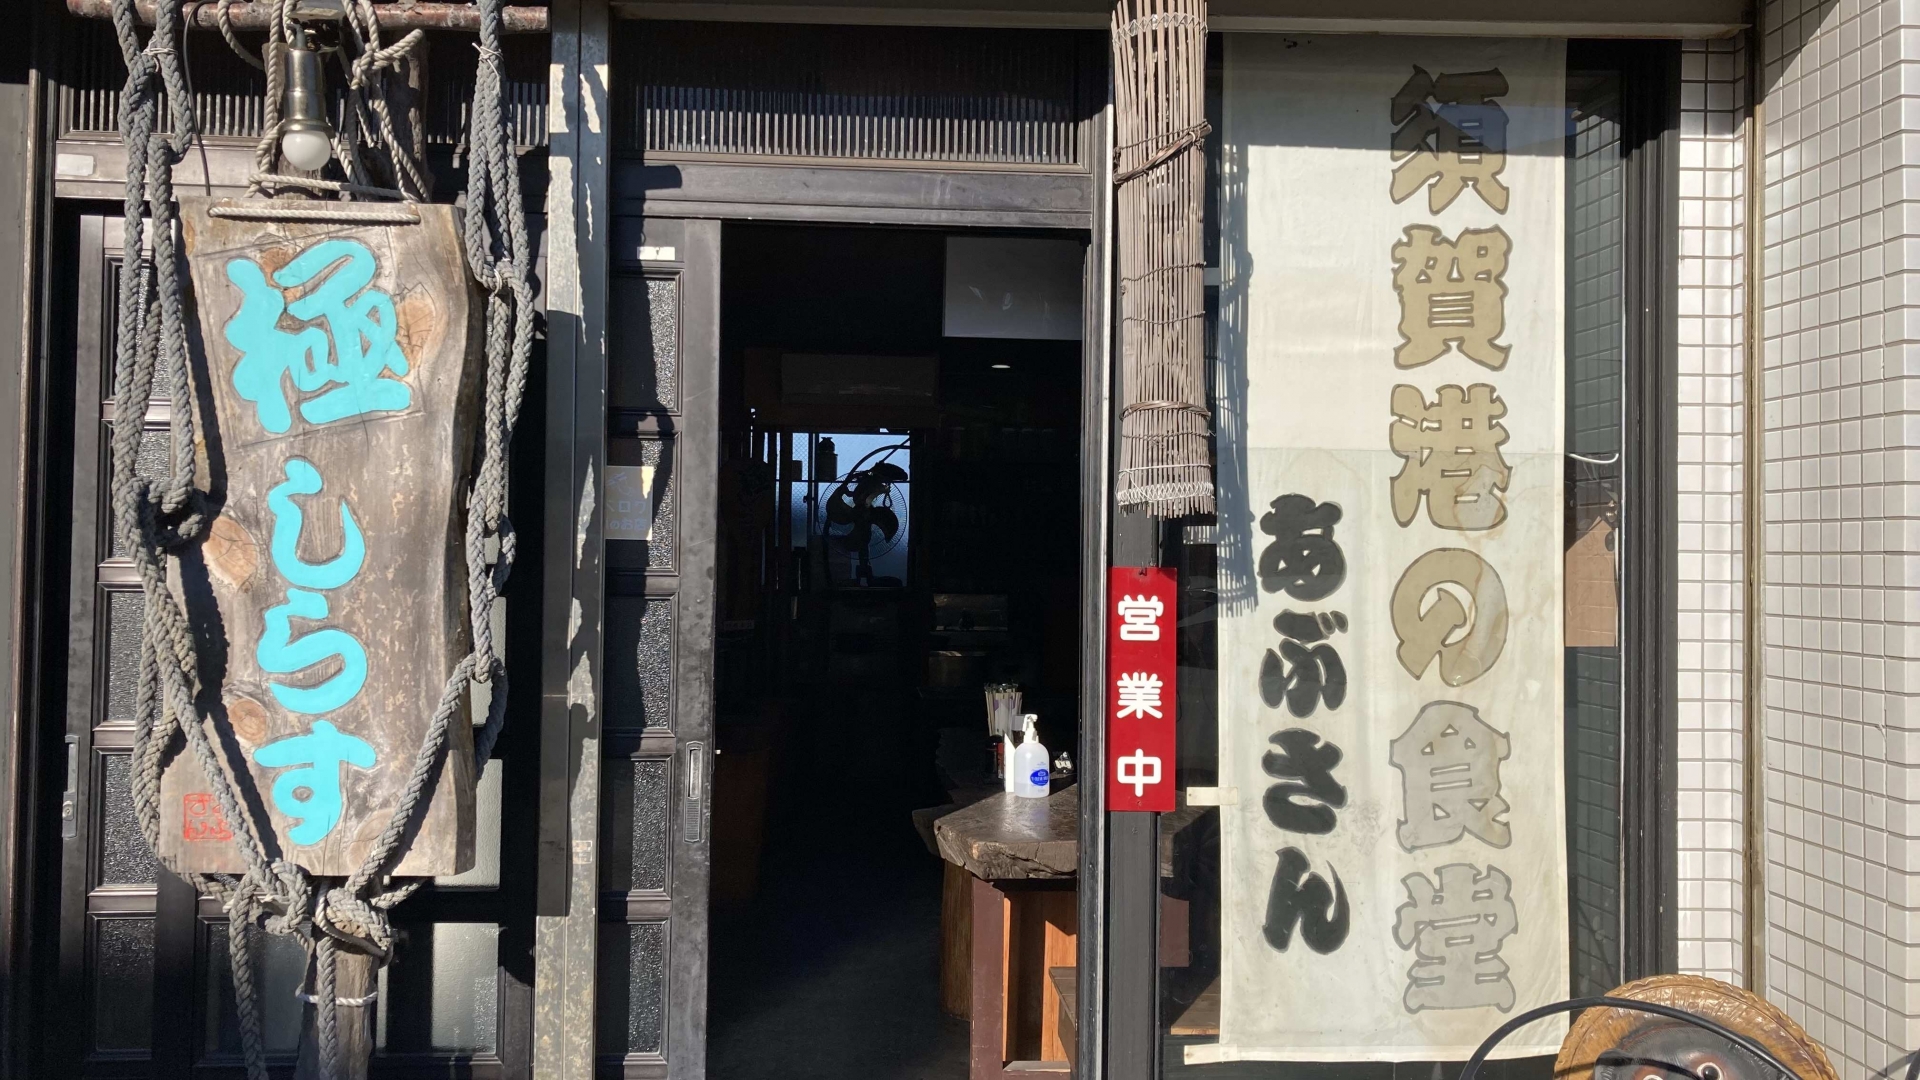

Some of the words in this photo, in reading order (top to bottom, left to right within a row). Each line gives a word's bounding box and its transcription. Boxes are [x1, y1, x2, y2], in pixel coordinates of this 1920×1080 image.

[224, 239, 412, 846] 極しらす
[1115, 593, 1165, 797] 営業中
[1259, 493, 1350, 955] あぶさん
[1389, 65, 1518, 1013] 須賀港の食堂
